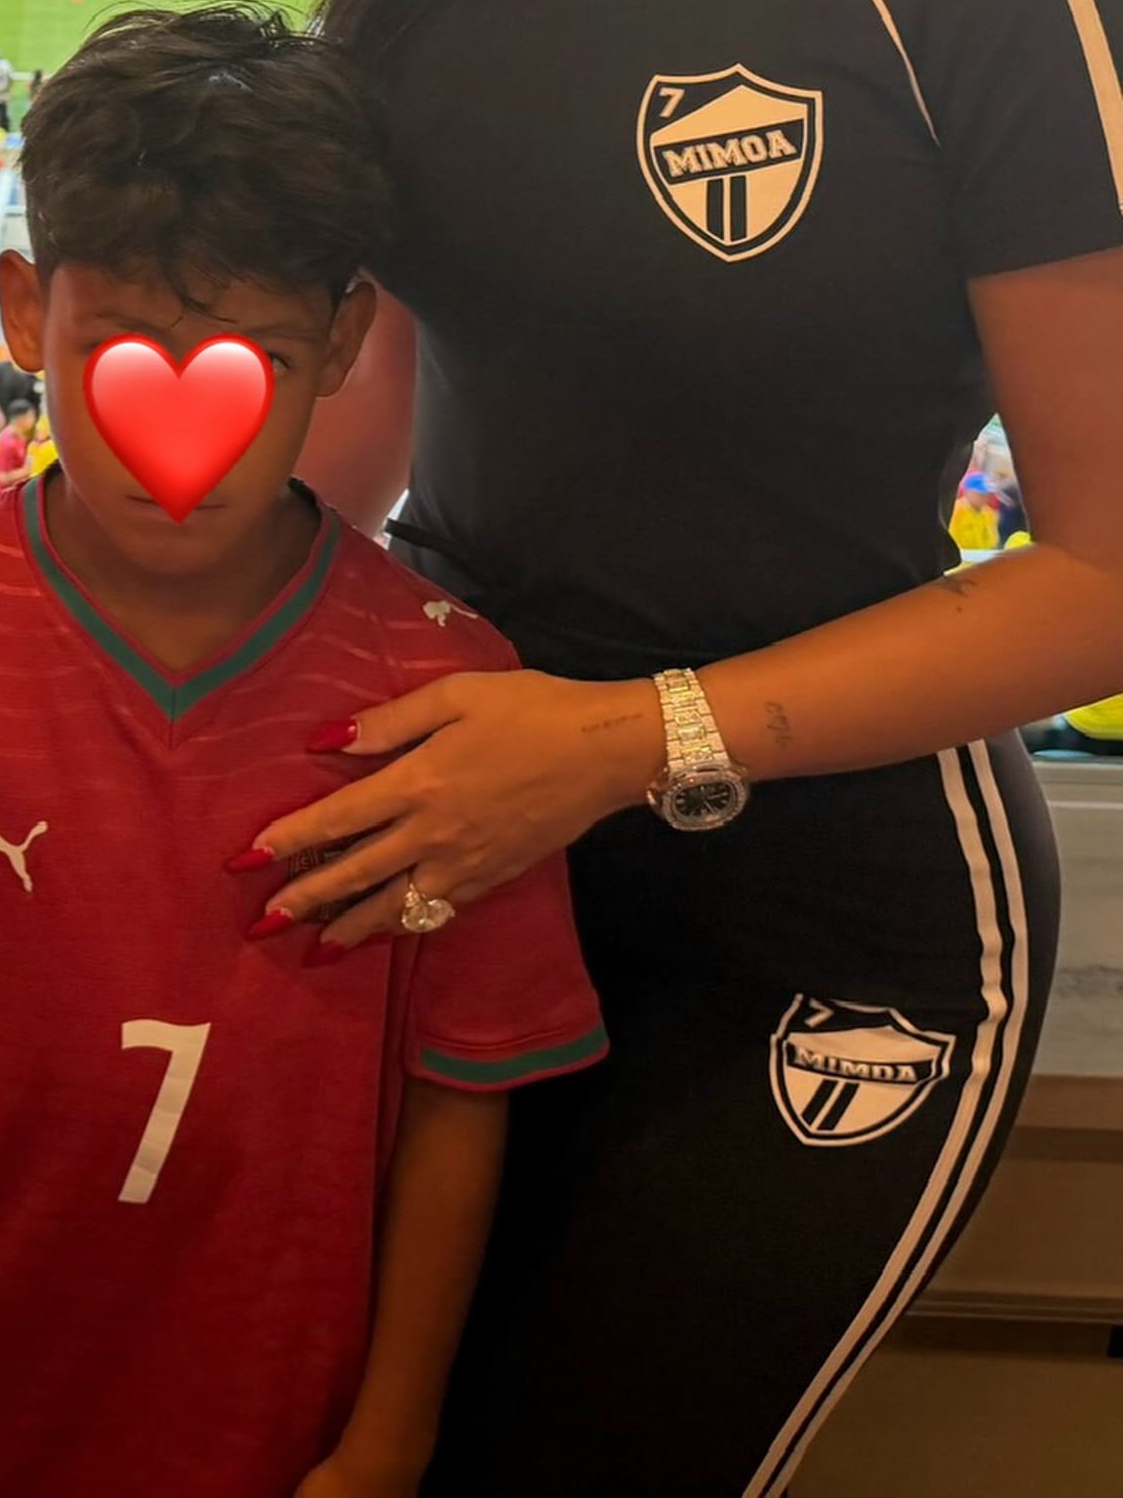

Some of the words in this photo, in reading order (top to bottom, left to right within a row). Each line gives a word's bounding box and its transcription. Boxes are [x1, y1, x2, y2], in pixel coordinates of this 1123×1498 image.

[659, 86, 686, 119] 7
[661, 129, 797, 178] MIMOA
[804, 997, 834, 1029] 7
[118, 1018, 212, 1205] 7
